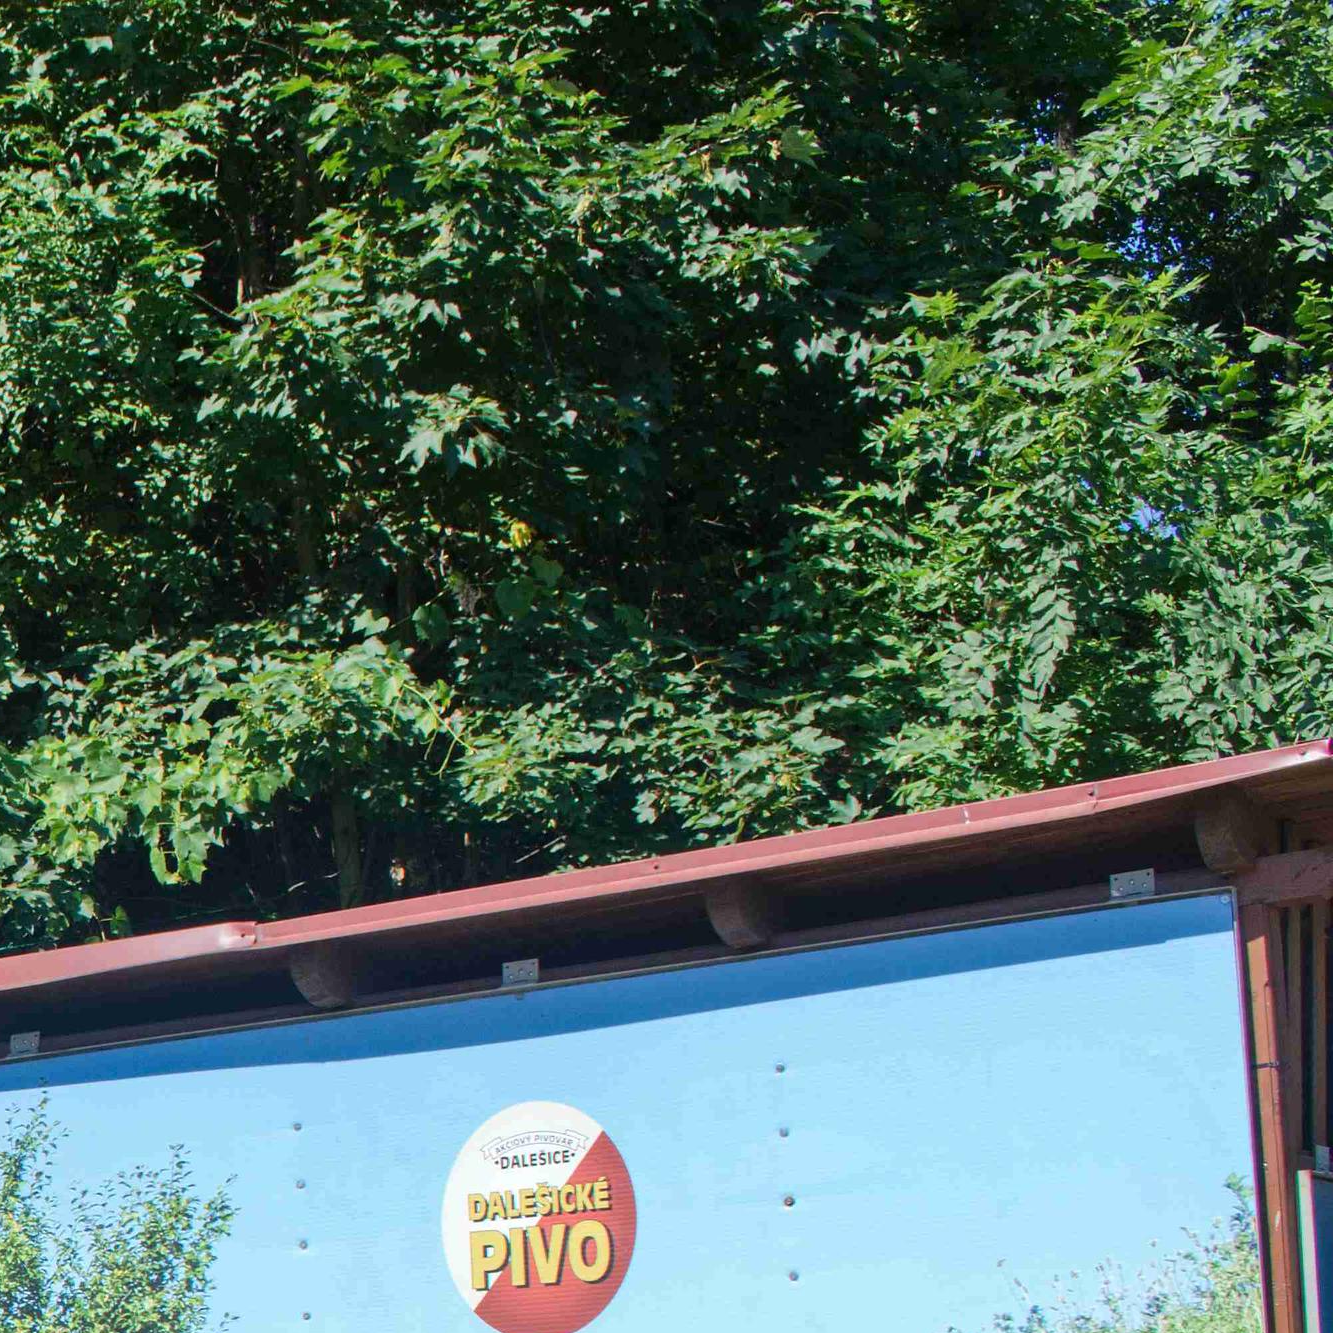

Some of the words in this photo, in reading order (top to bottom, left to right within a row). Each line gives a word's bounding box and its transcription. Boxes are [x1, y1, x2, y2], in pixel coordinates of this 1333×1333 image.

[534, 1134, 574, 1145] PIVOVAR
[467, 1176, 612, 1223] DALEŠICKÉ
[469, 1219, 615, 1291] PIVO
